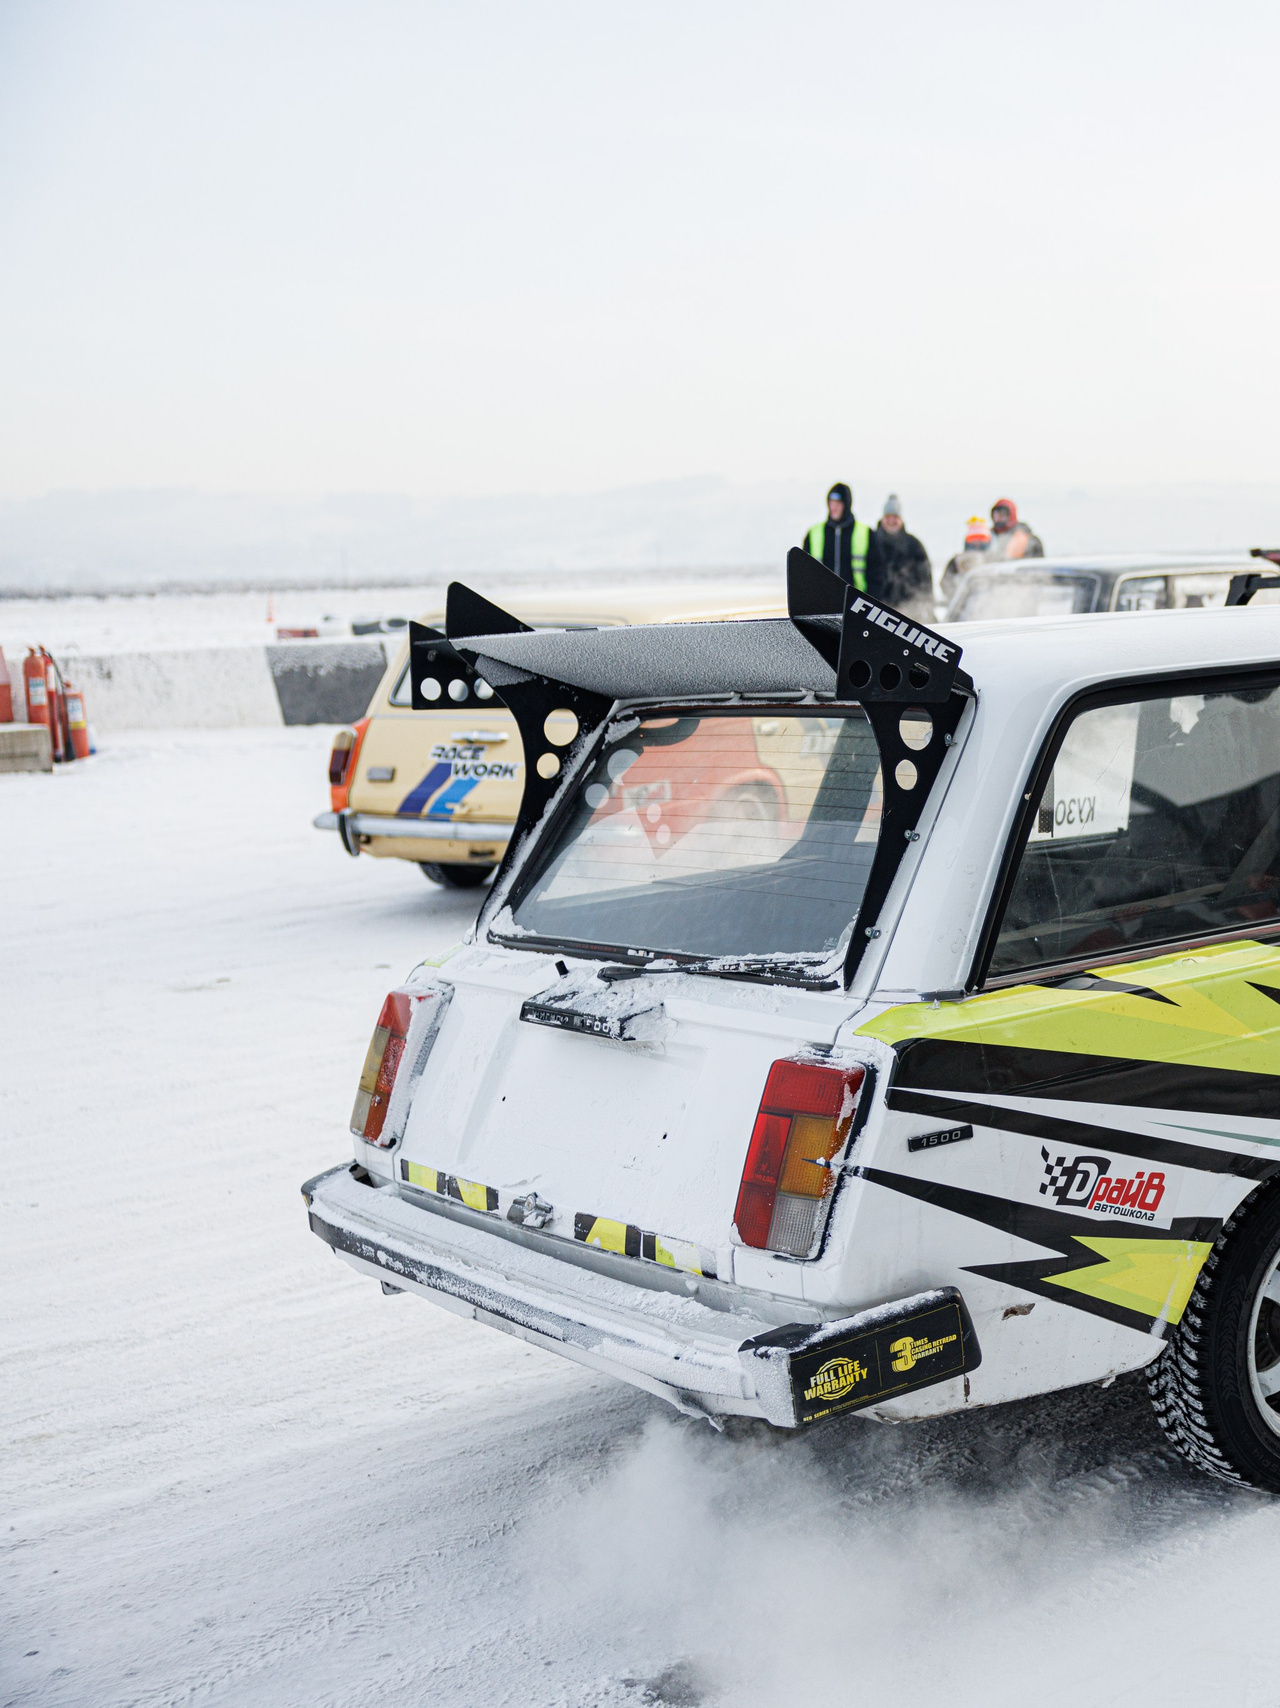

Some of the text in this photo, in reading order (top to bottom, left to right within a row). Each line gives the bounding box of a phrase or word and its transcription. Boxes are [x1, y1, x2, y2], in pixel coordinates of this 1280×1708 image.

[850, 597, 956, 664] FIGURE
[430, 745, 485, 760] RACE
[453, 763, 517, 778] WORK
[921, 1130, 961, 1147] 1500
[1093, 1202, 1156, 1221] автошкола
[910, 1337, 929, 1348] TIMES
[889, 1336, 917, 1373] 3
[911, 1345, 944, 1361] WARRANTY
[810, 1360, 860, 1388] FULL LIFE
[803, 1367, 868, 1401] WARRANTY
